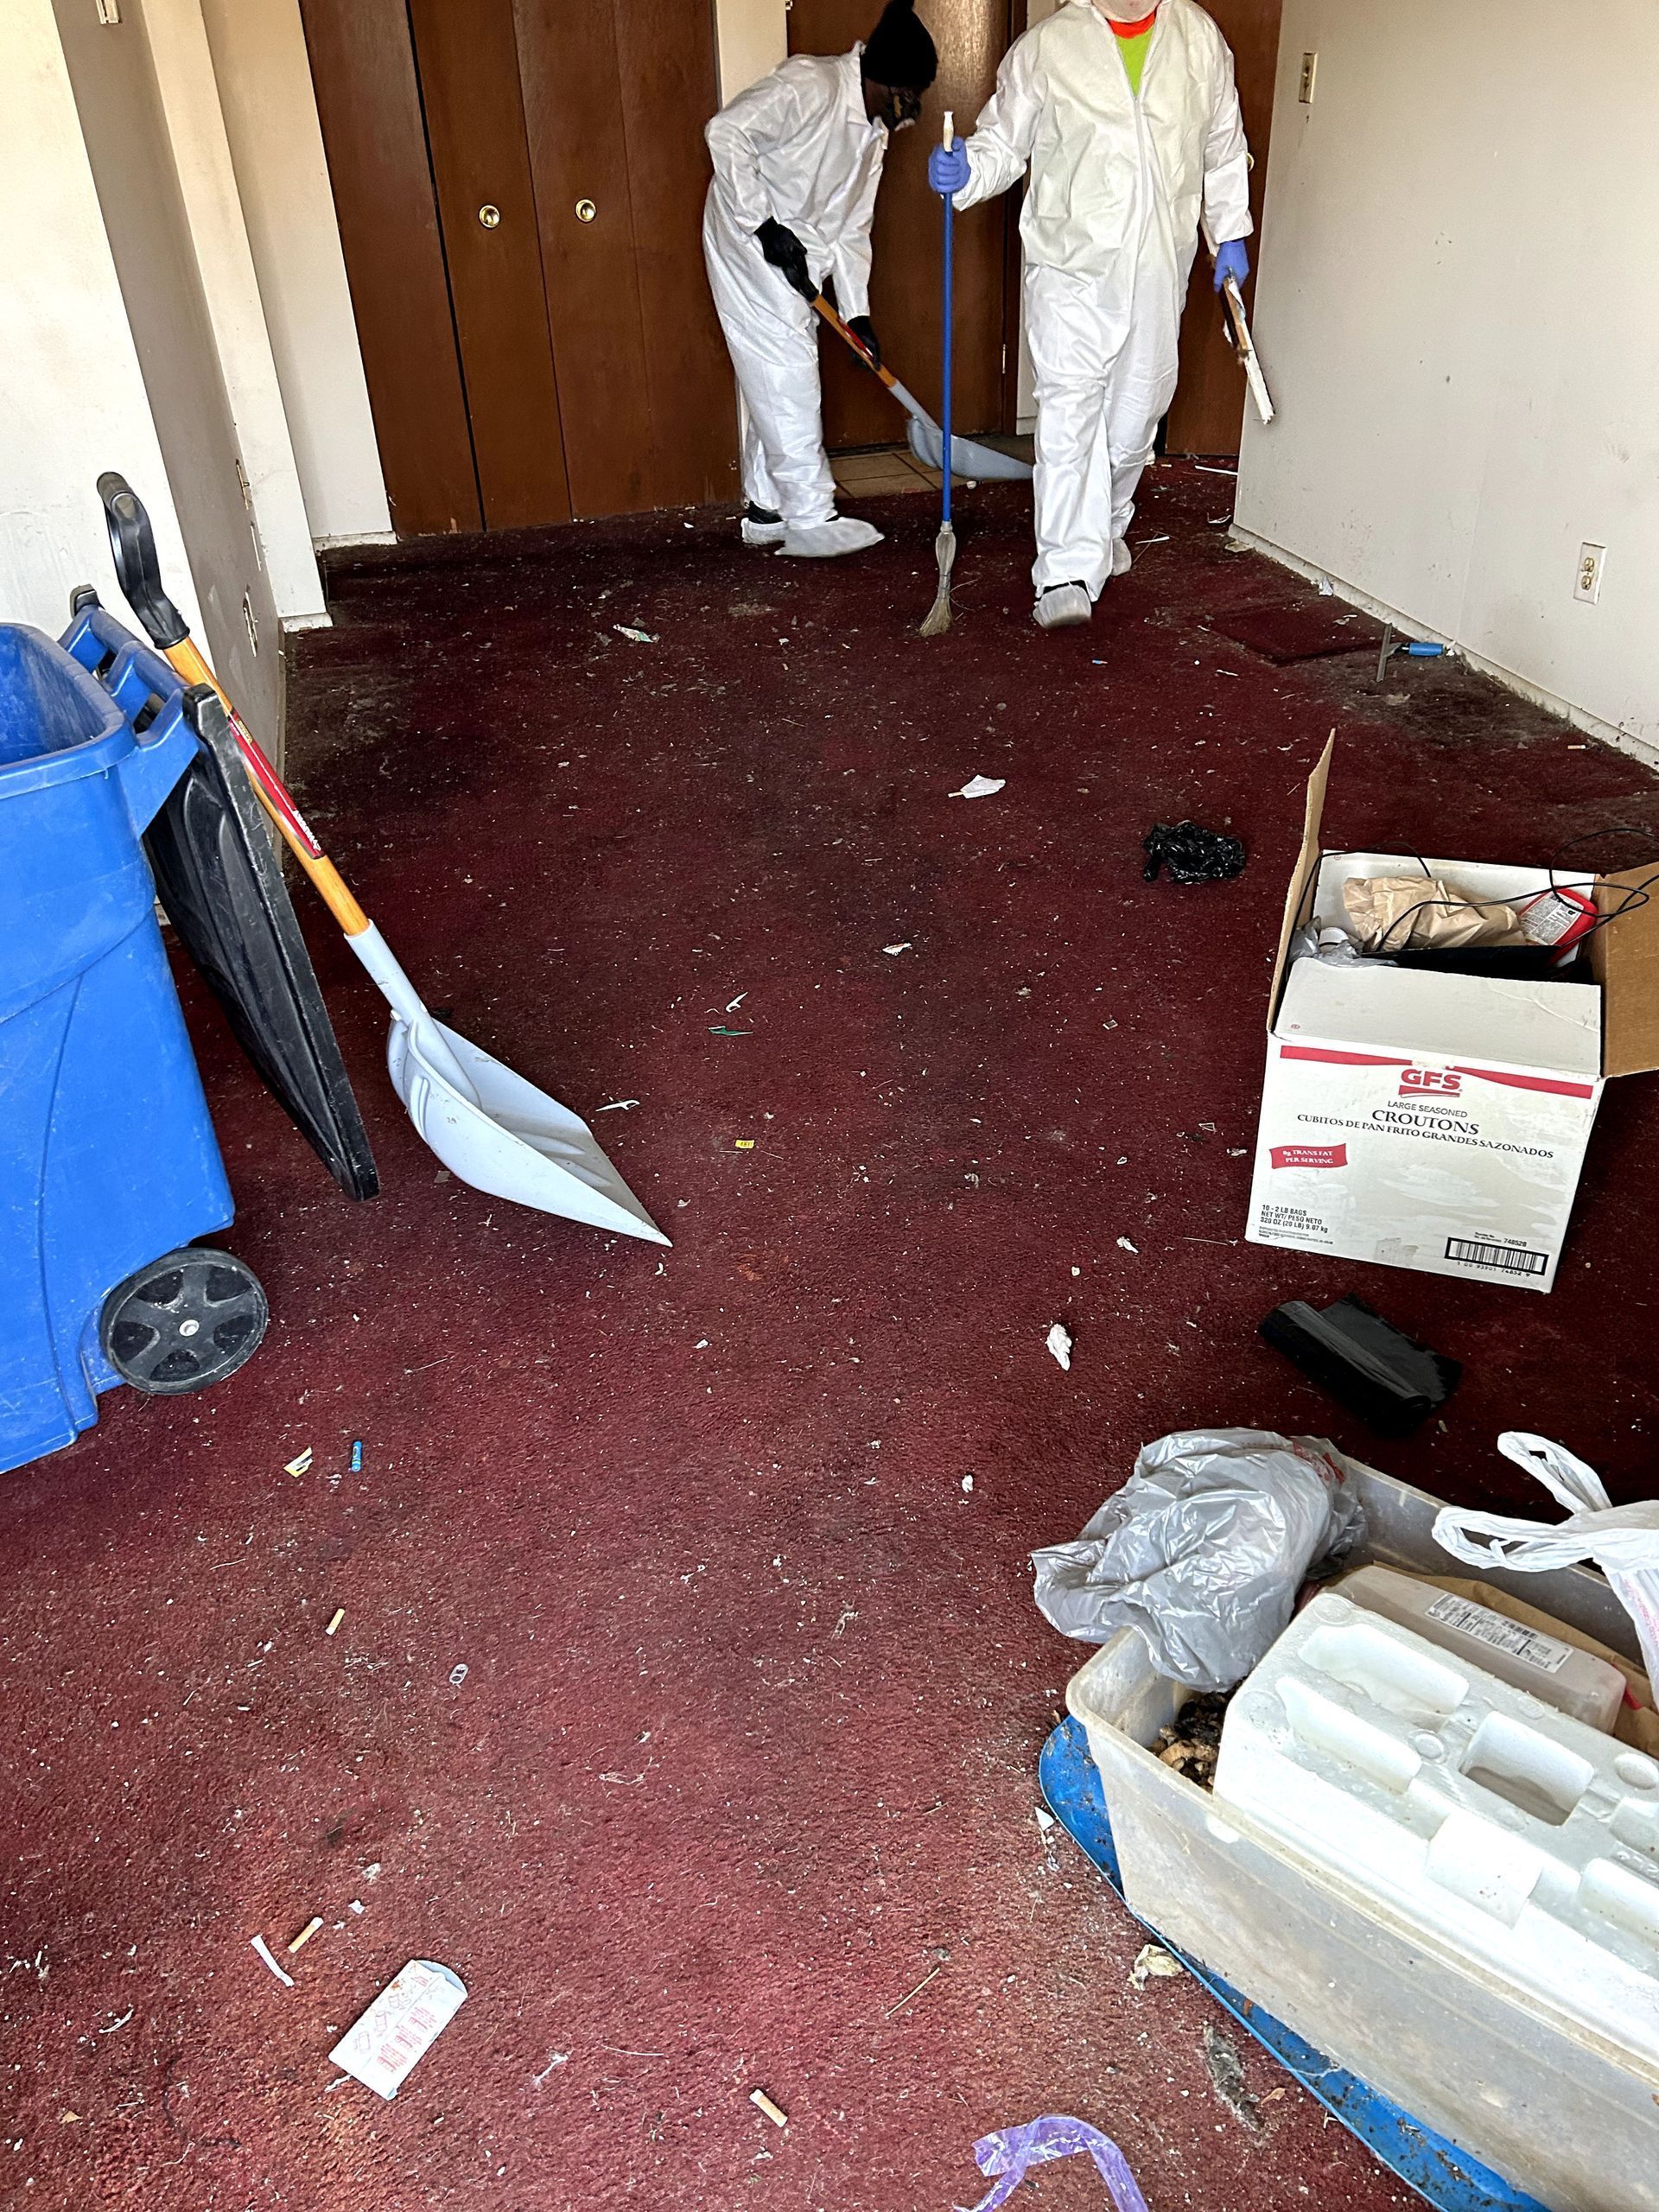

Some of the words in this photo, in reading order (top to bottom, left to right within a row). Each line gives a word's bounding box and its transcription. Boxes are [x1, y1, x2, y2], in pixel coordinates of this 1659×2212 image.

[1401, 1068, 1462, 1090] GFS
[1387, 1100, 1417, 1111] LARGE
[1419, 1104, 1468, 1118] SEASONED
[1371, 1109, 1480, 1135] CROUTONS
[1297, 1114, 1344, 1127] CUBITOS
[1345, 1120, 1361, 1128] DE
[1362, 1122, 1386, 1132] PAN
[1387, 1126, 1421, 1137] FRITO
[1422, 1131, 1478, 1147] GRANDES
[1478, 1140, 1554, 1159] SAZONADOS
[1288, 1214, 1305, 1223] PESO
[1290, 1208, 1307, 1217] BAGS
